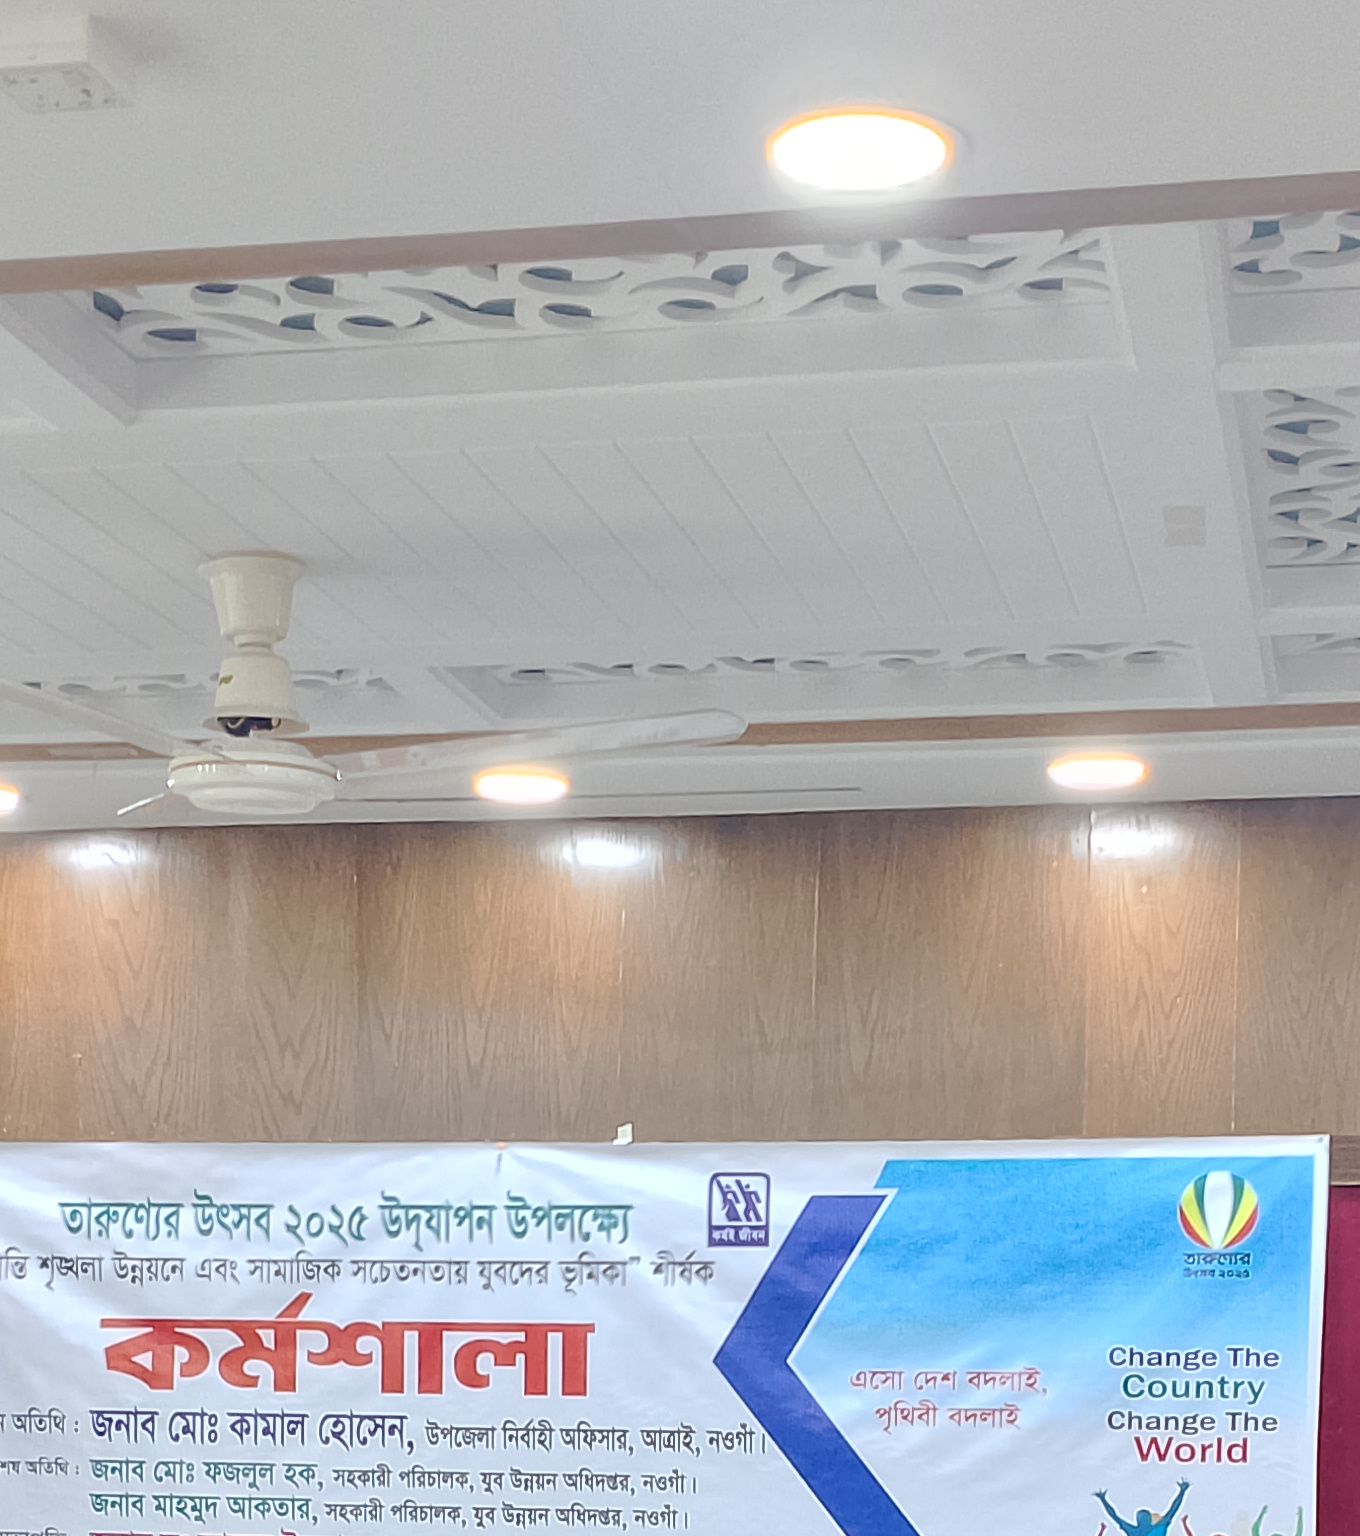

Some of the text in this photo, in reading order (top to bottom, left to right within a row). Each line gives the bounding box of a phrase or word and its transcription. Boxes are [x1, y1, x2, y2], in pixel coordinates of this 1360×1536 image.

[192, 1189, 274, 1241] উৎসব
[285, 1205, 368, 1246] ২০২৫
[196, 1259, 239, 1283] এবং
[247, 1250, 342, 1284] সামাজিক
[477, 1261, 551, 1291] যুবদের
[100, 1292, 595, 1396] কর্মশালা
[1109, 1347, 1279, 1370] Change The
[851, 1371, 904, 1390] এসো
[914, 1371, 957, 1390] দেশ
[1123, 1375, 1264, 1405] Country
[11, 1407, 66, 1434] অতিথি
[89, 1406, 159, 1443] জনাব
[227, 1408, 309, 1447] কামাল
[319, 1410, 413, 1455] হোসেন,
[425, 1419, 497, 1449] উপজেলা
[501, 1419, 555, 1452] নির্বাহী
[875, 1400, 1020, 1434] পৃথিবী বদলাই
[1108, 1411, 1277, 1435] Change The
[1134, 1437, 1247, 1463] World
[25, 1457, 69, 1475] অতিথি
[89, 1458, 146, 1483] জনাব
[202, 1462, 276, 1491] ফজলুল
[282, 1464, 323, 1491] হক,
[332, 1464, 392, 1489] সহকারী
[480, 1473, 505, 1494] যুব
[89, 1493, 145, 1517] জনাব
[152, 1493, 221, 1524] মাহমুদ
[226, 1497, 317, 1525] আকতার,
[324, 1498, 385, 1523] সহকারী
[472, 1507, 496, 1528] যুব
